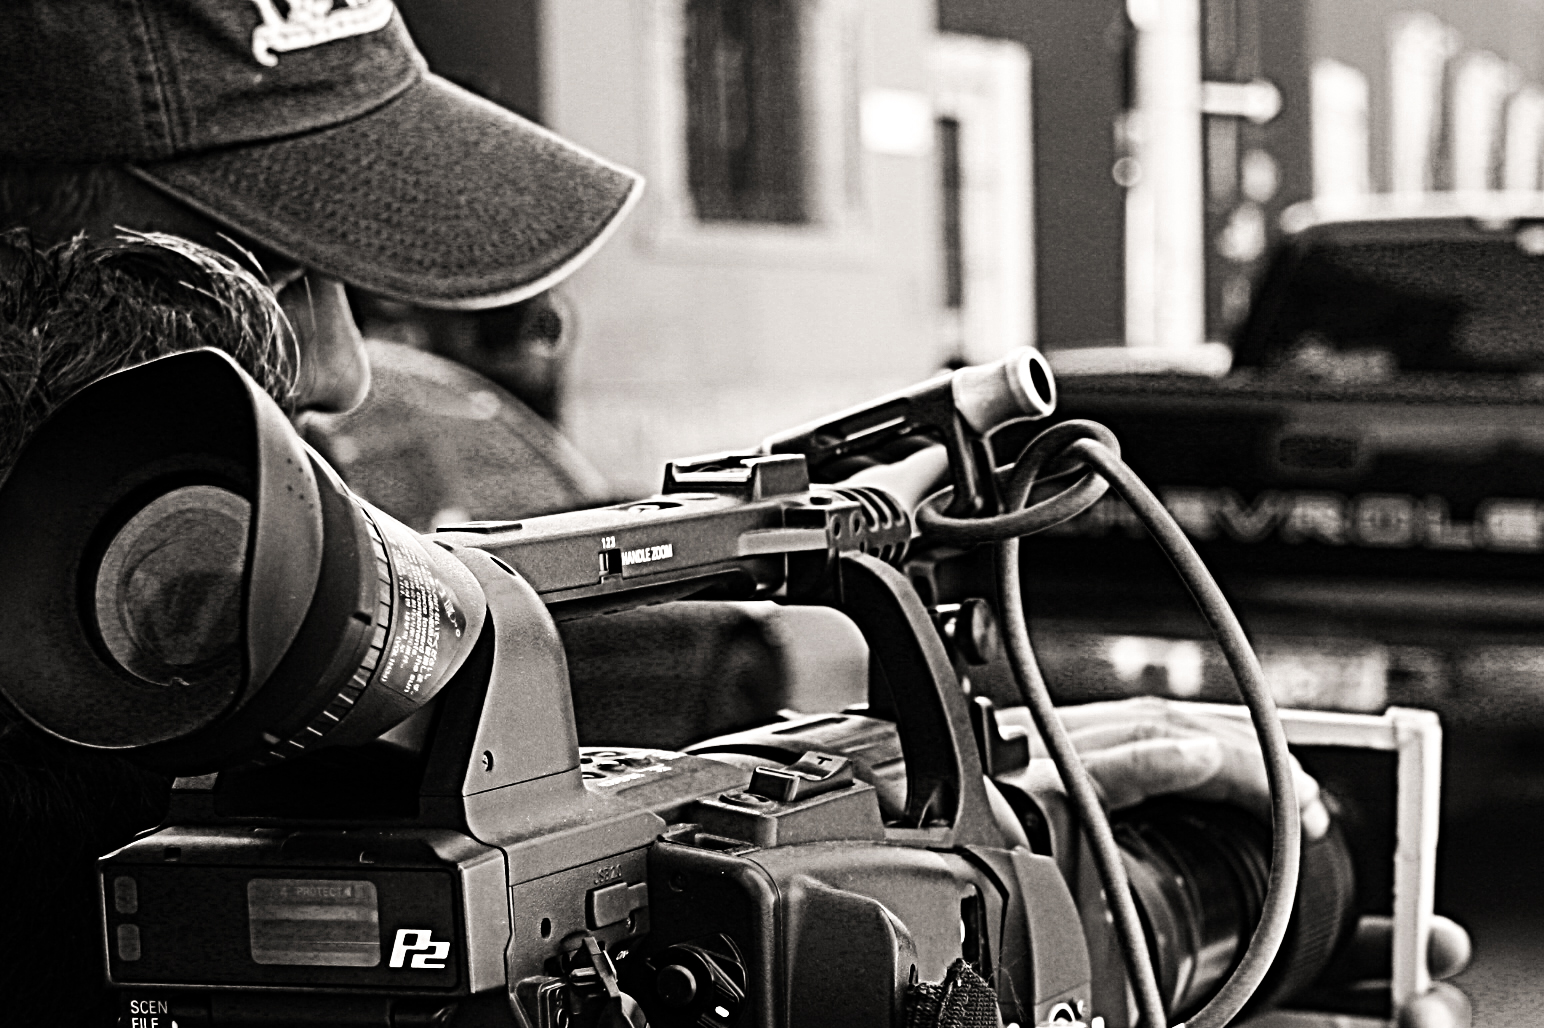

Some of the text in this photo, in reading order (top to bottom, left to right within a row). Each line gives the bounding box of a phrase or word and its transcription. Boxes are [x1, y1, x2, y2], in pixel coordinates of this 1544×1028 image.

[621, 543, 673, 566] HANDLE ZOOM
[389, 929, 450, 968] P2
